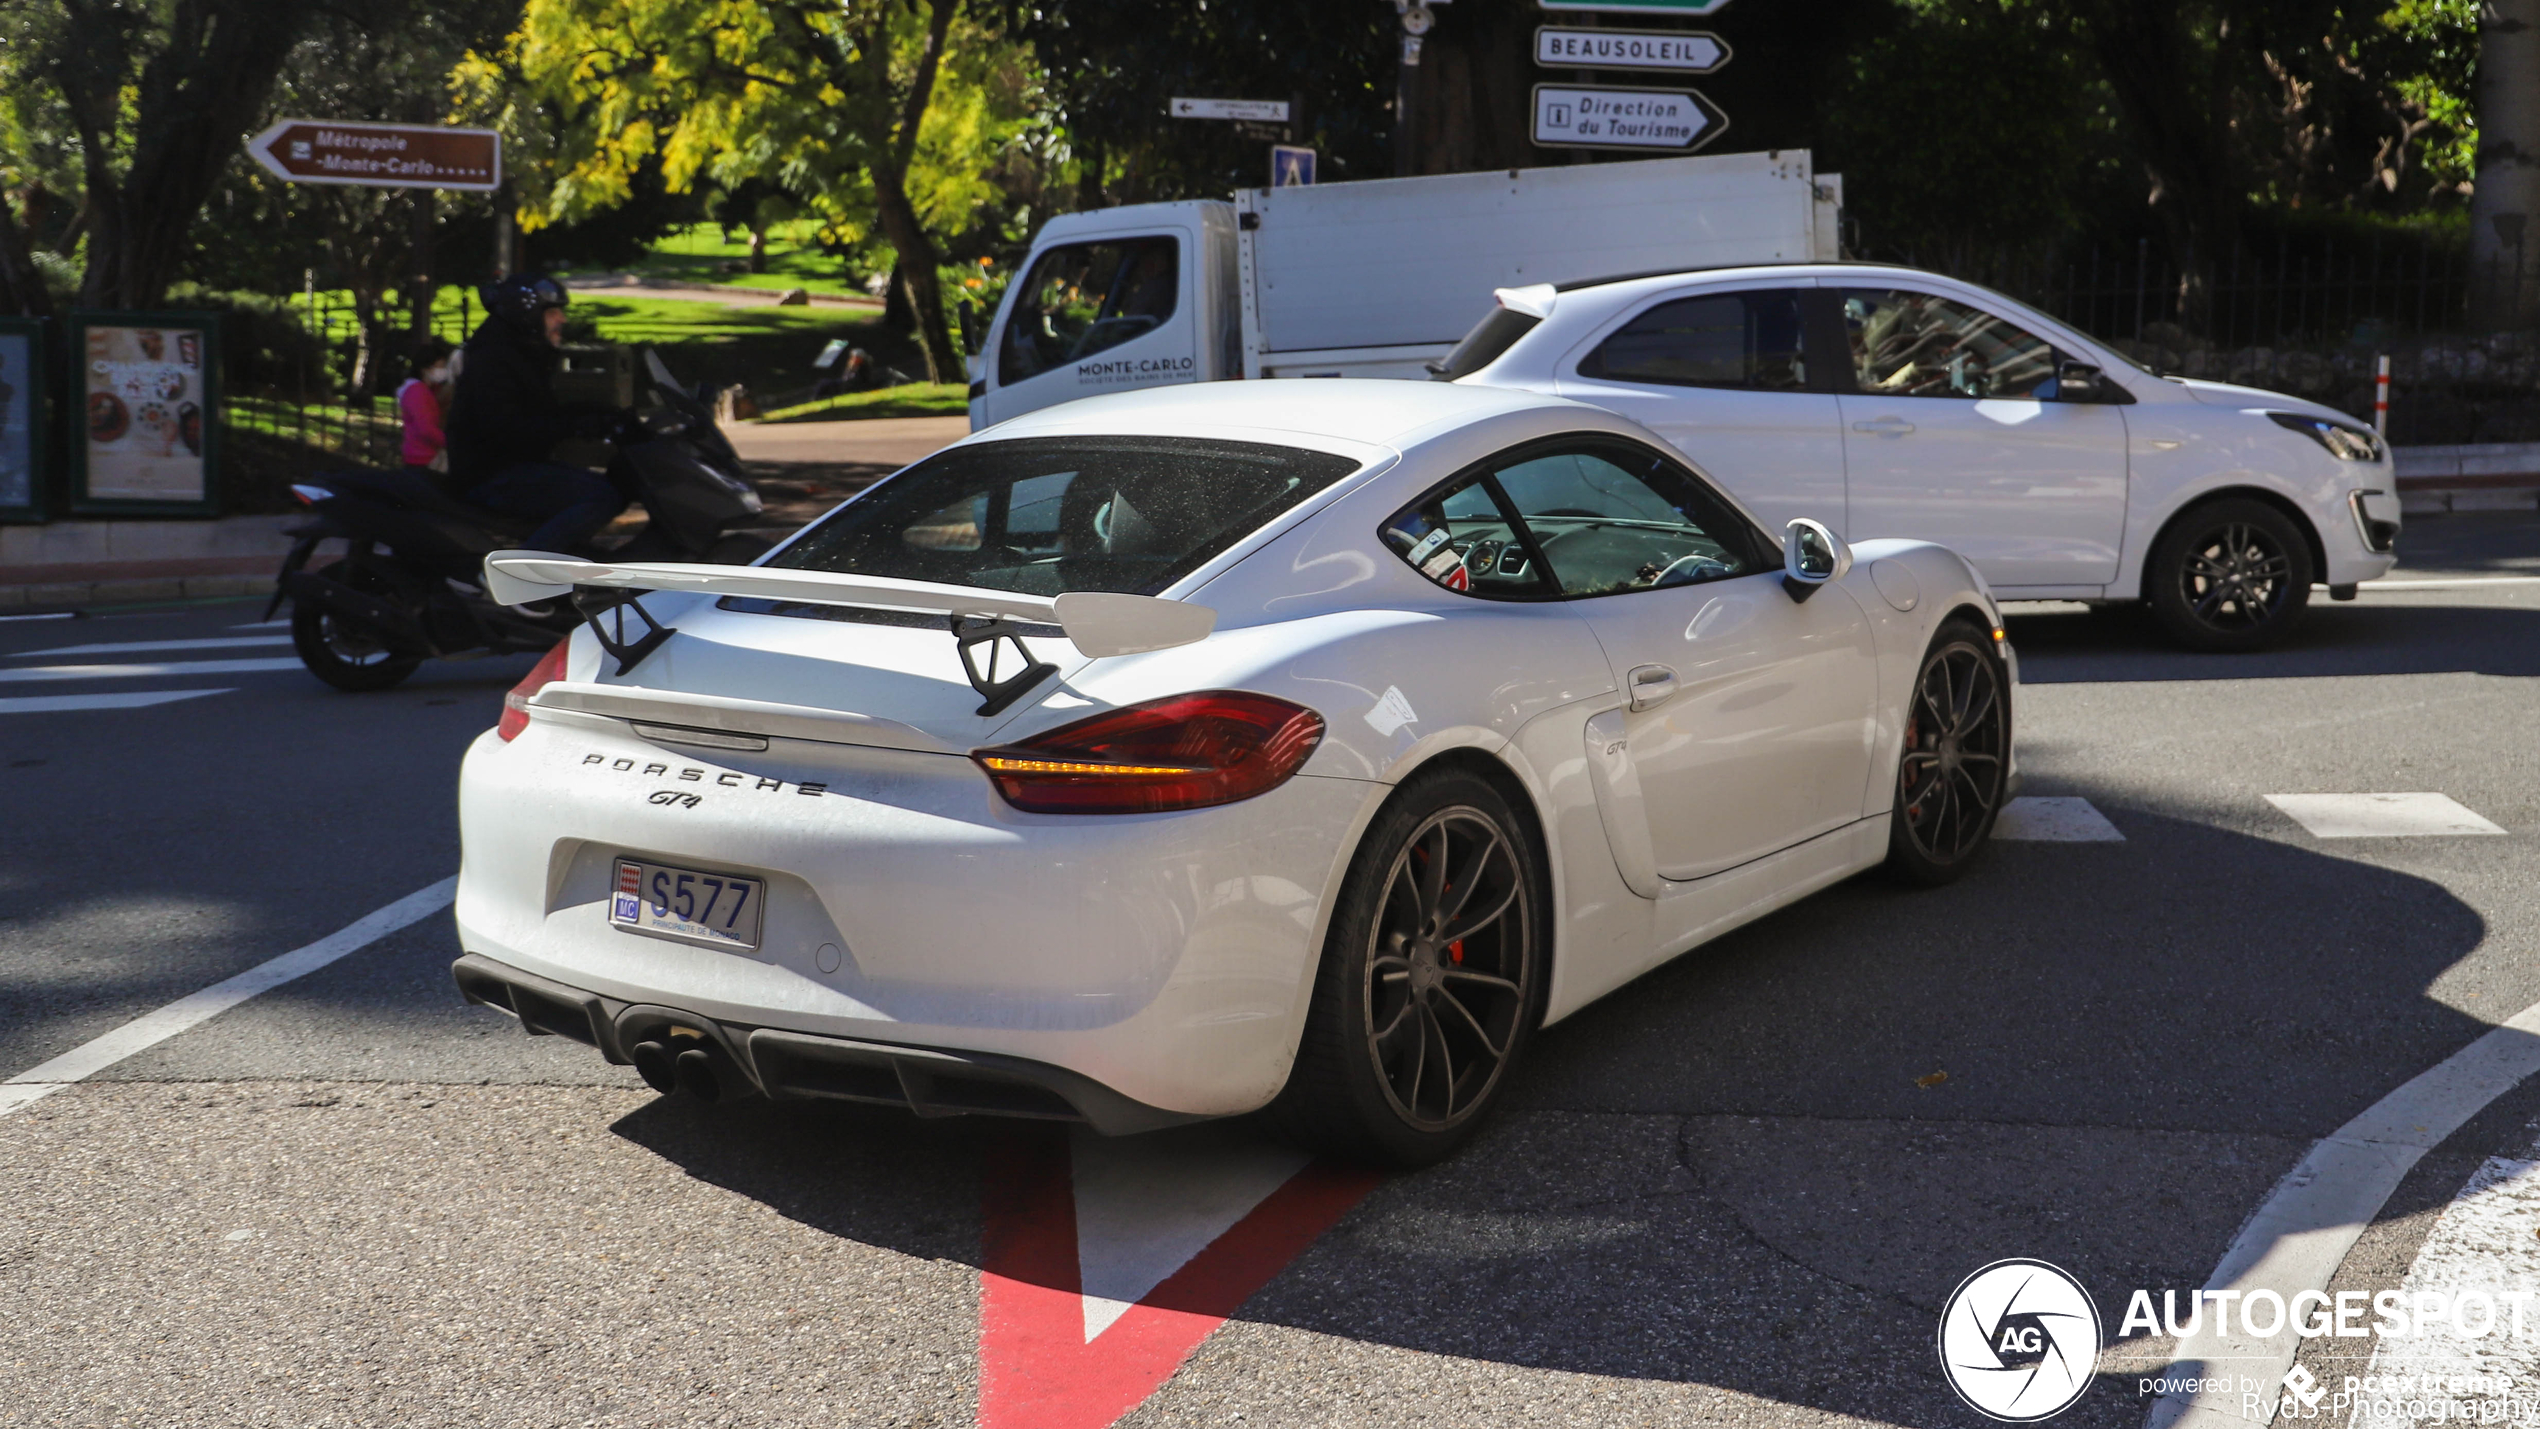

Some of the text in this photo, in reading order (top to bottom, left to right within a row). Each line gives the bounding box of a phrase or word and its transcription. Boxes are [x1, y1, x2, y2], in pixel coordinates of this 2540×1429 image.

[1550, 37, 1695, 61] BEAUSOLEIL
[1579, 96, 1678, 118] Direction
[1578, 118, 1690, 138] du Tourisme
[1078, 357, 1193, 376] MONTE-CARLO
[1606, 740, 1627, 755] GT4
[581, 753, 828, 798] PORSCHE
[647, 790, 703, 810] GT4
[619, 900, 636, 917] MC
[651, 870, 751, 929] S577
[652, 919, 741, 941] PRINCIPAUTE DE MONACO
